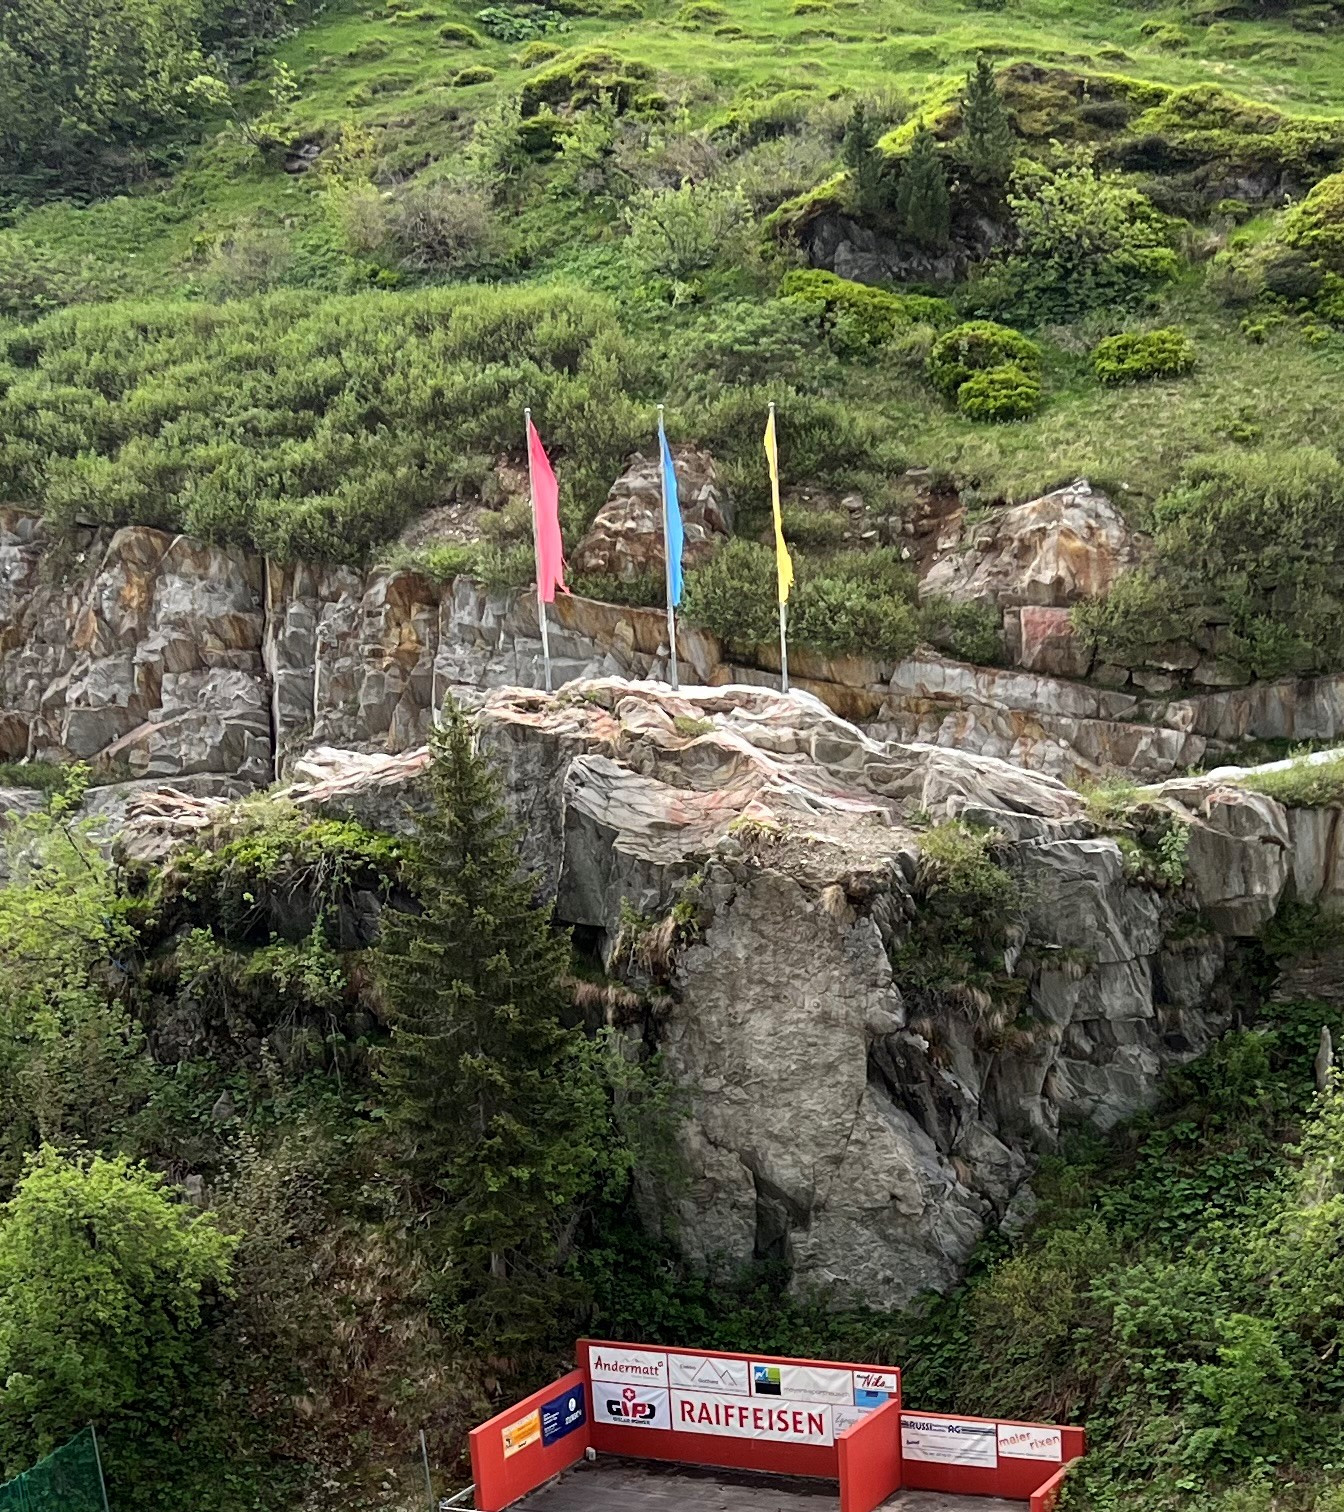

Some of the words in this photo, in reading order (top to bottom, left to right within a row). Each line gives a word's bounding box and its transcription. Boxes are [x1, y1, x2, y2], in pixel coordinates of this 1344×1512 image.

[594, 1355, 659, 1376] Andermatt
[680, 1400, 824, 1435] RAIFFEISEN
[909, 1420, 933, 1431] RUSSI
[947, 1424, 961, 1433] AG
